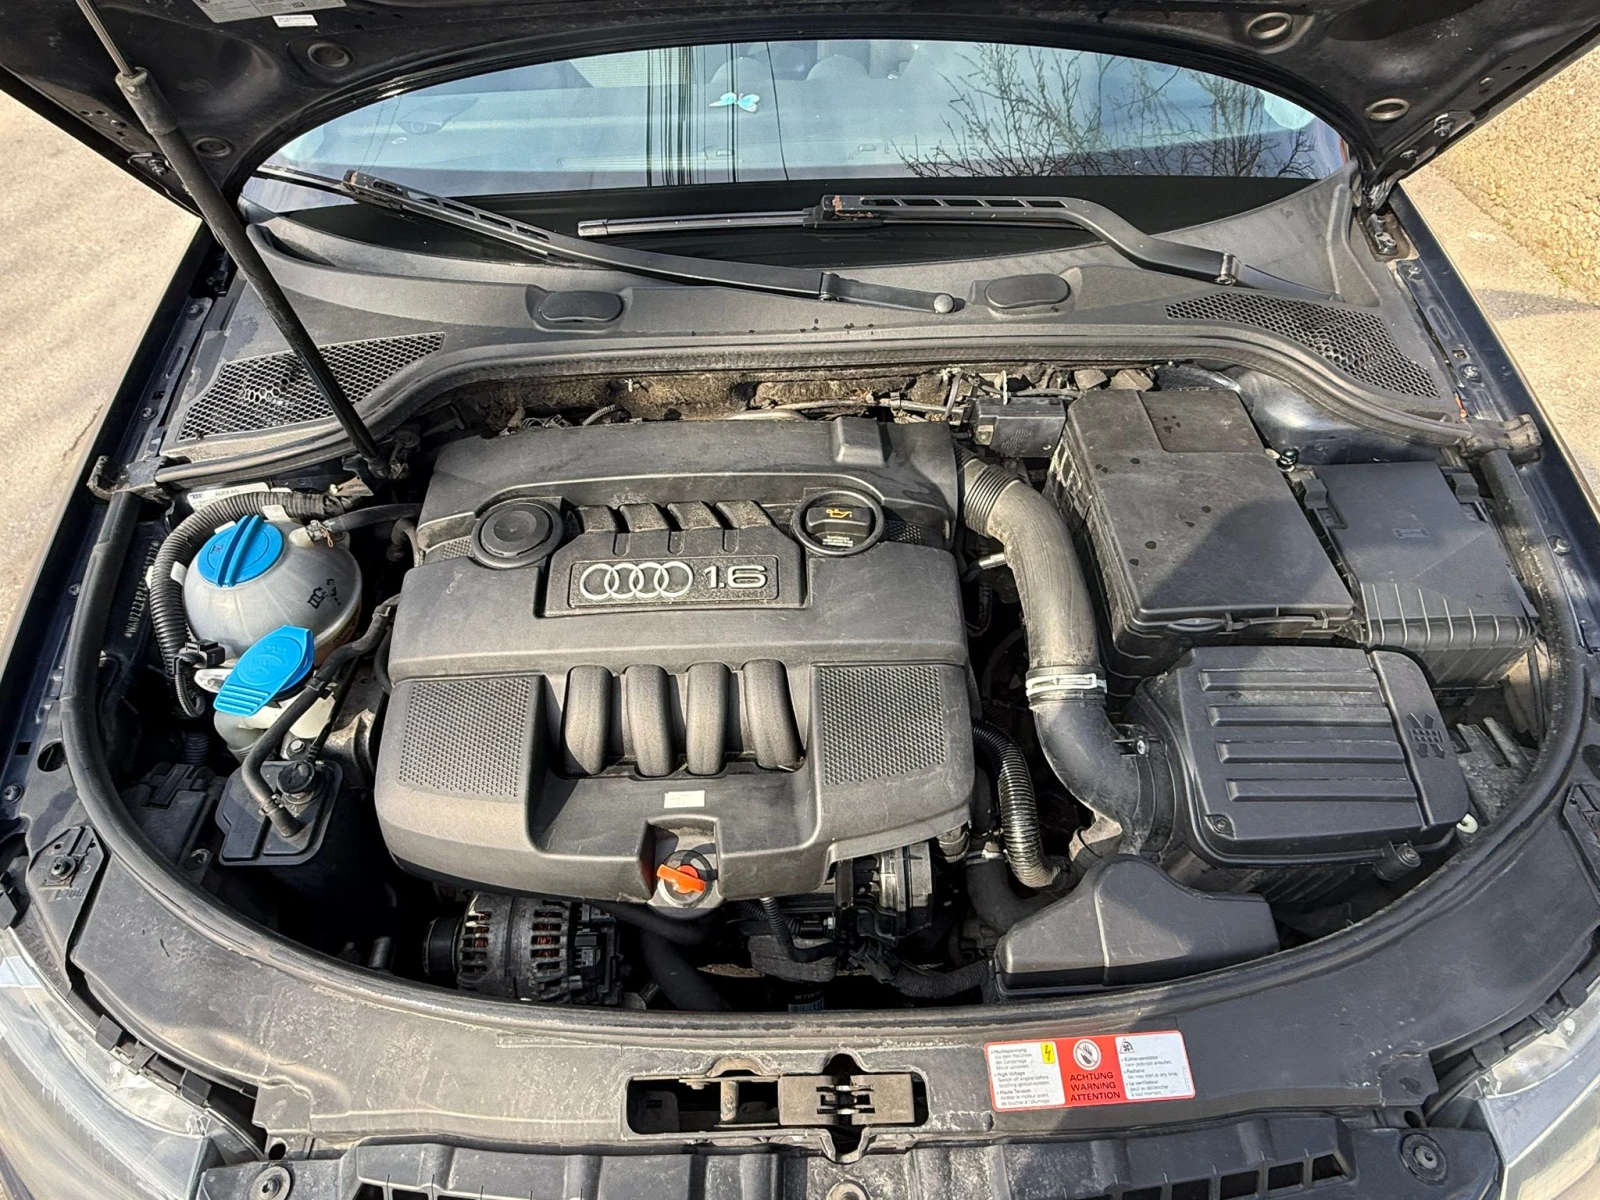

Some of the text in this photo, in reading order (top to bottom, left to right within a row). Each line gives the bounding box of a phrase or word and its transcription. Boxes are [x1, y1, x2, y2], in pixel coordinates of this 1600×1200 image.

[704, 565, 767, 589] 1.6
[1070, 1071, 1114, 1081] ACHTUNG
[1070, 1081, 1116, 1091] WARNING
[1070, 1091, 1121, 1102] ATTENTION
